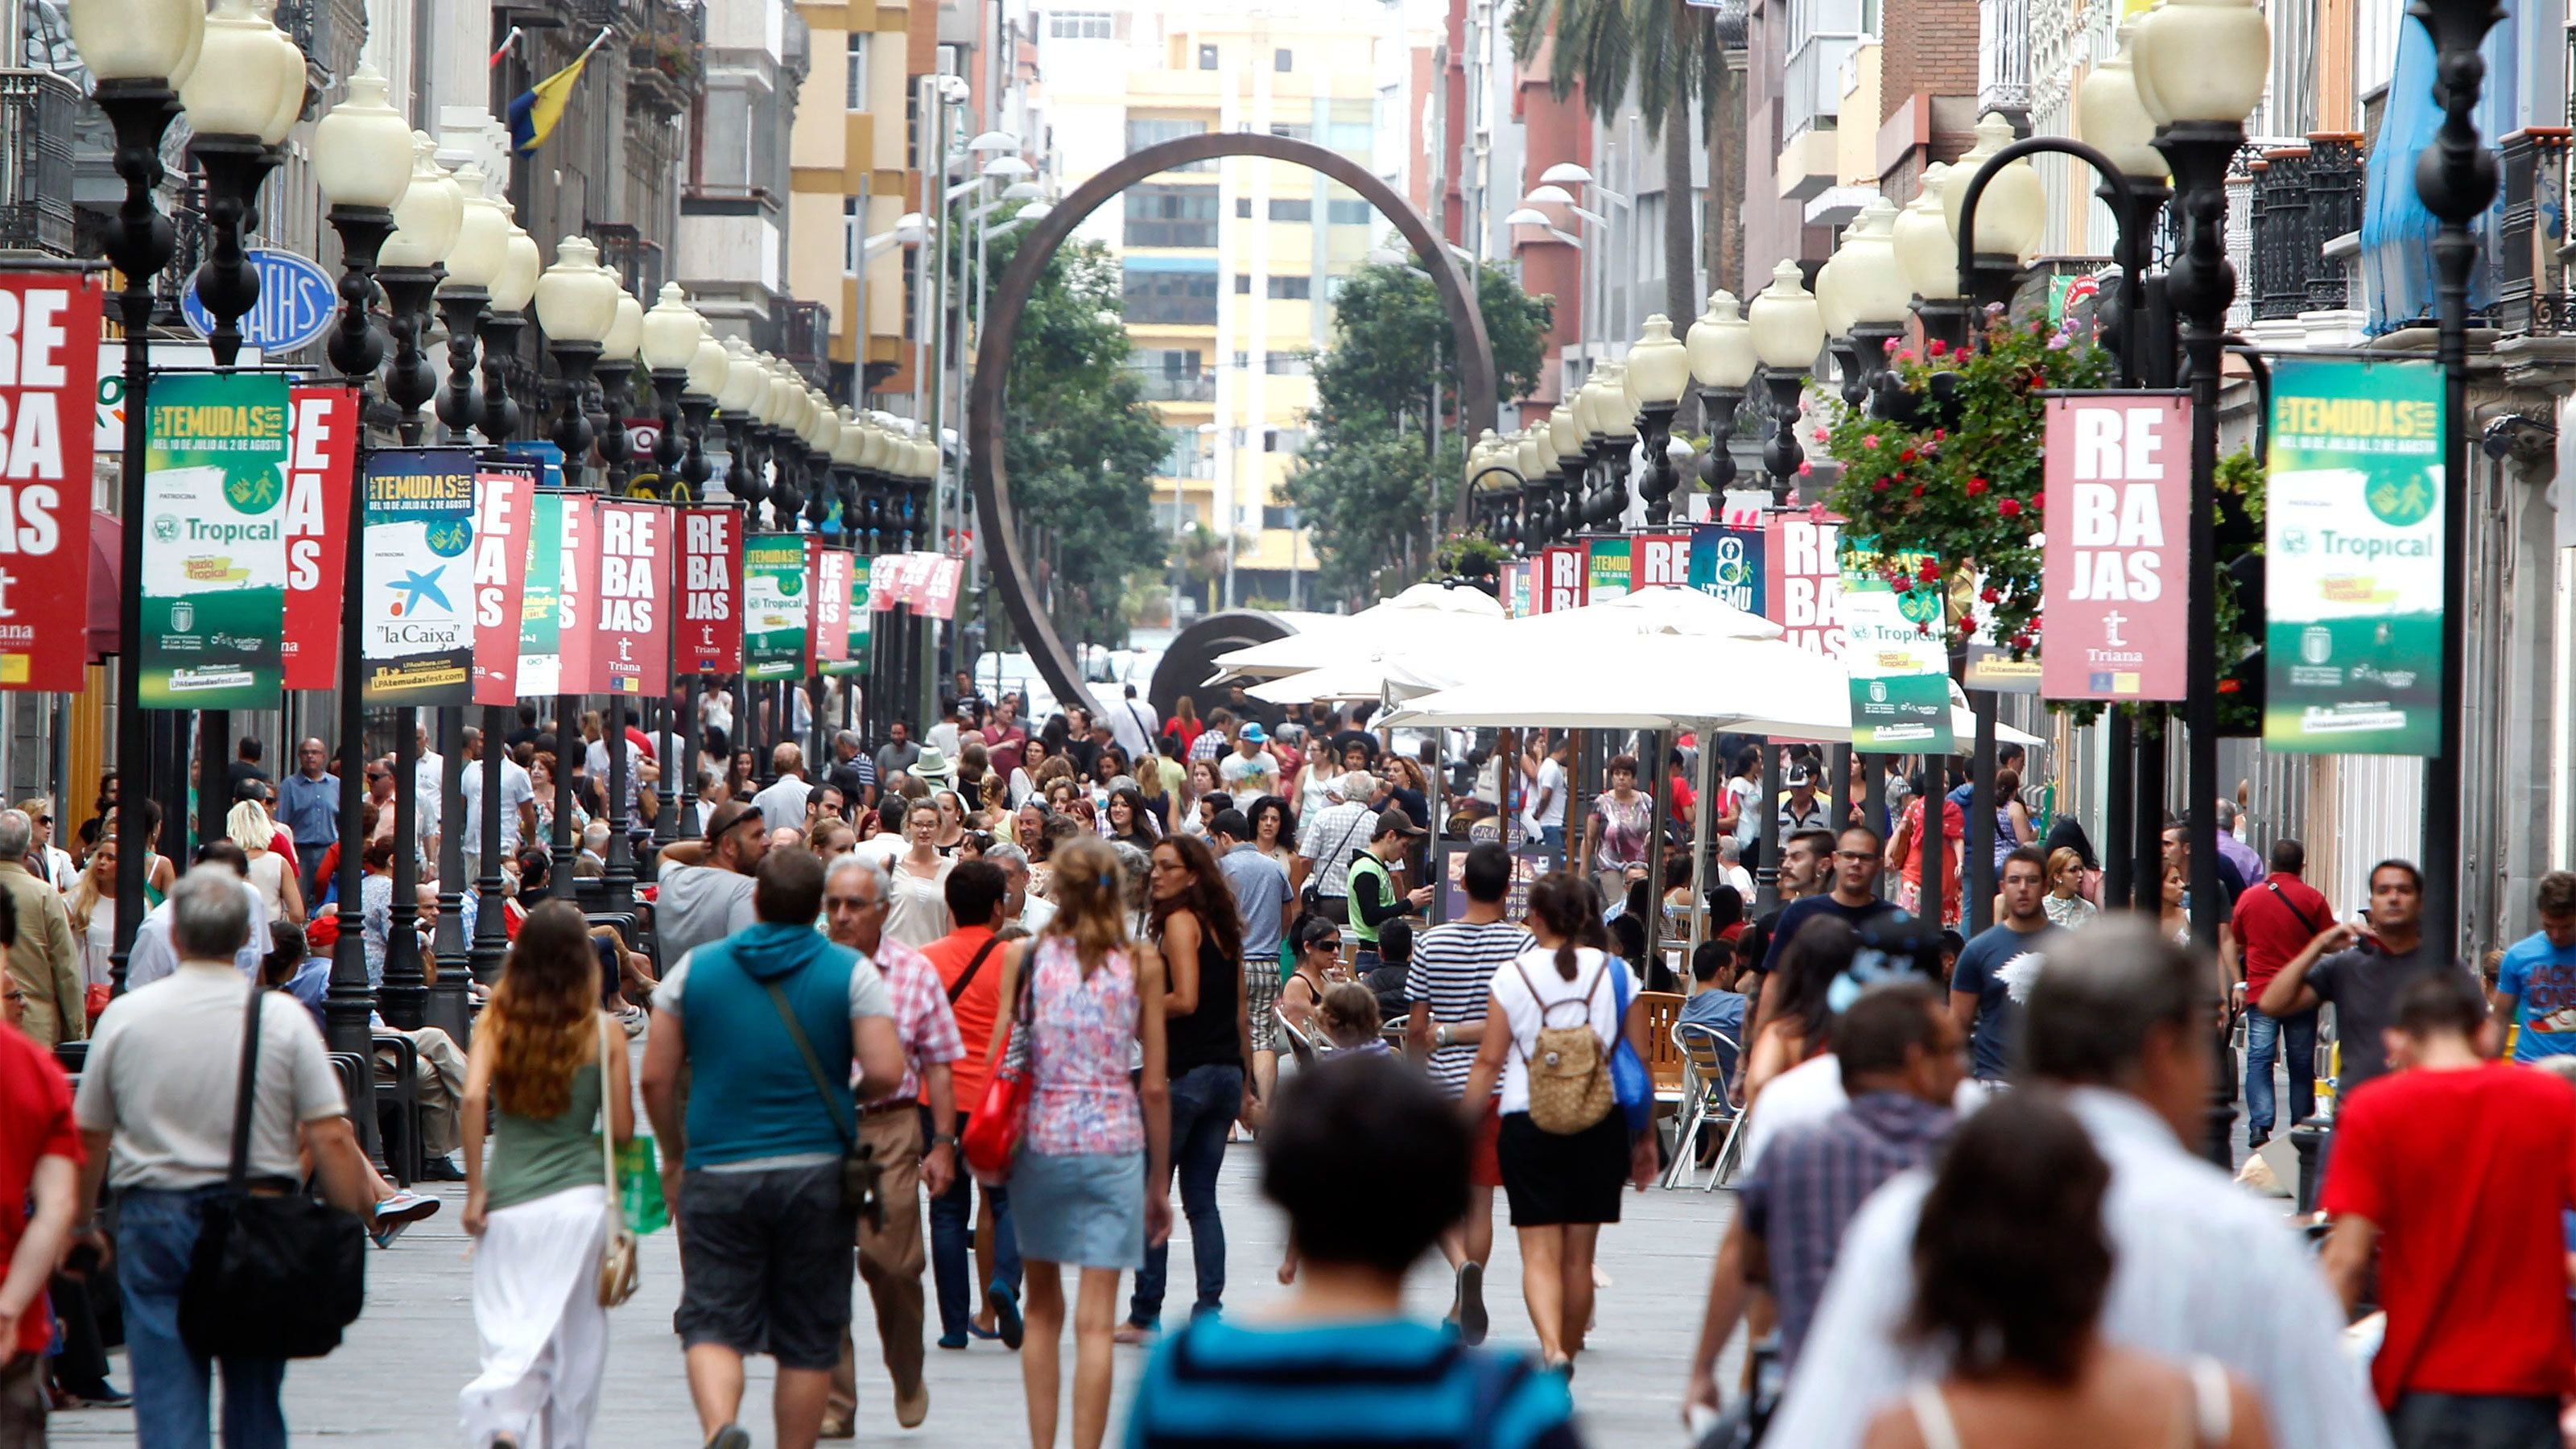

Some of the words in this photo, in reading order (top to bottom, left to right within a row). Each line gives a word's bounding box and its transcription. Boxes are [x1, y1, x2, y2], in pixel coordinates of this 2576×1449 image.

[0, 392, 64, 478] A
[163, 406, 266, 436] TEMUDAS
[264, 405, 283, 437] FEST
[287, 398, 332, 469] E
[2289, 397, 2416, 438] TEMUDAS
[153, 440, 167, 450] DEL
[171, 440, 180, 450] 10
[181, 440, 192, 450] DE
[192, 440, 217, 451] JULIO
[217, 440, 229, 450] AL
[229, 440, 237, 450] 2
[237, 440, 248, 450] DE
[249, 440, 281, 451] AGOSTO
[2074, 407, 2164, 480] RE
[285, 473, 324, 536] A
[369, 501, 382, 510] DEL
[383, 501, 390, 510] 10
[391, 501, 400, 510] DE
[400, 501, 419, 510] JULIO
[420, 500, 428, 510] AL
[430, 500, 436, 510] 2
[436, 500, 444, 510] DE
[445, 499, 471, 509] AGOSTO
[375, 475, 457, 499] TEMUDAS
[457, 474, 471, 498] FEST
[474, 480, 514, 535] E
[561, 500, 580, 548] E
[2072, 482, 2165, 547] BA
[186, 518, 279, 545] Tropical
[603, 510, 655, 556] RE
[686, 514, 729, 554] RE
[1784, 520, 1839, 576] RE
[2320, 529, 2434, 562] Tropical
[188, 568, 228, 580] Tropical
[473, 535, 508, 586] A
[559, 549, 578, 592] A
[687, 555, 730, 591] BA
[750, 549, 794, 564] TEMUDAS
[1645, 541, 1690, 584] RE
[601, 555, 655, 599] BA
[2068, 551, 2162, 602] JAS
[598, 598, 653, 634] JAS
[686, 592, 729, 621] JAS
[762, 598, 802, 609] Tropical
[1785, 576, 1843, 627] BA
[608, 660, 642, 672] Triana
[694, 646, 720, 654] Triana
[1880, 659, 1909, 667] Tropical
[2087, 648, 2144, 662] Triana
[171, 675, 251, 689] LPAtemudasfest.com
[374, 672, 464, 689] LPAtemudasfest.com
